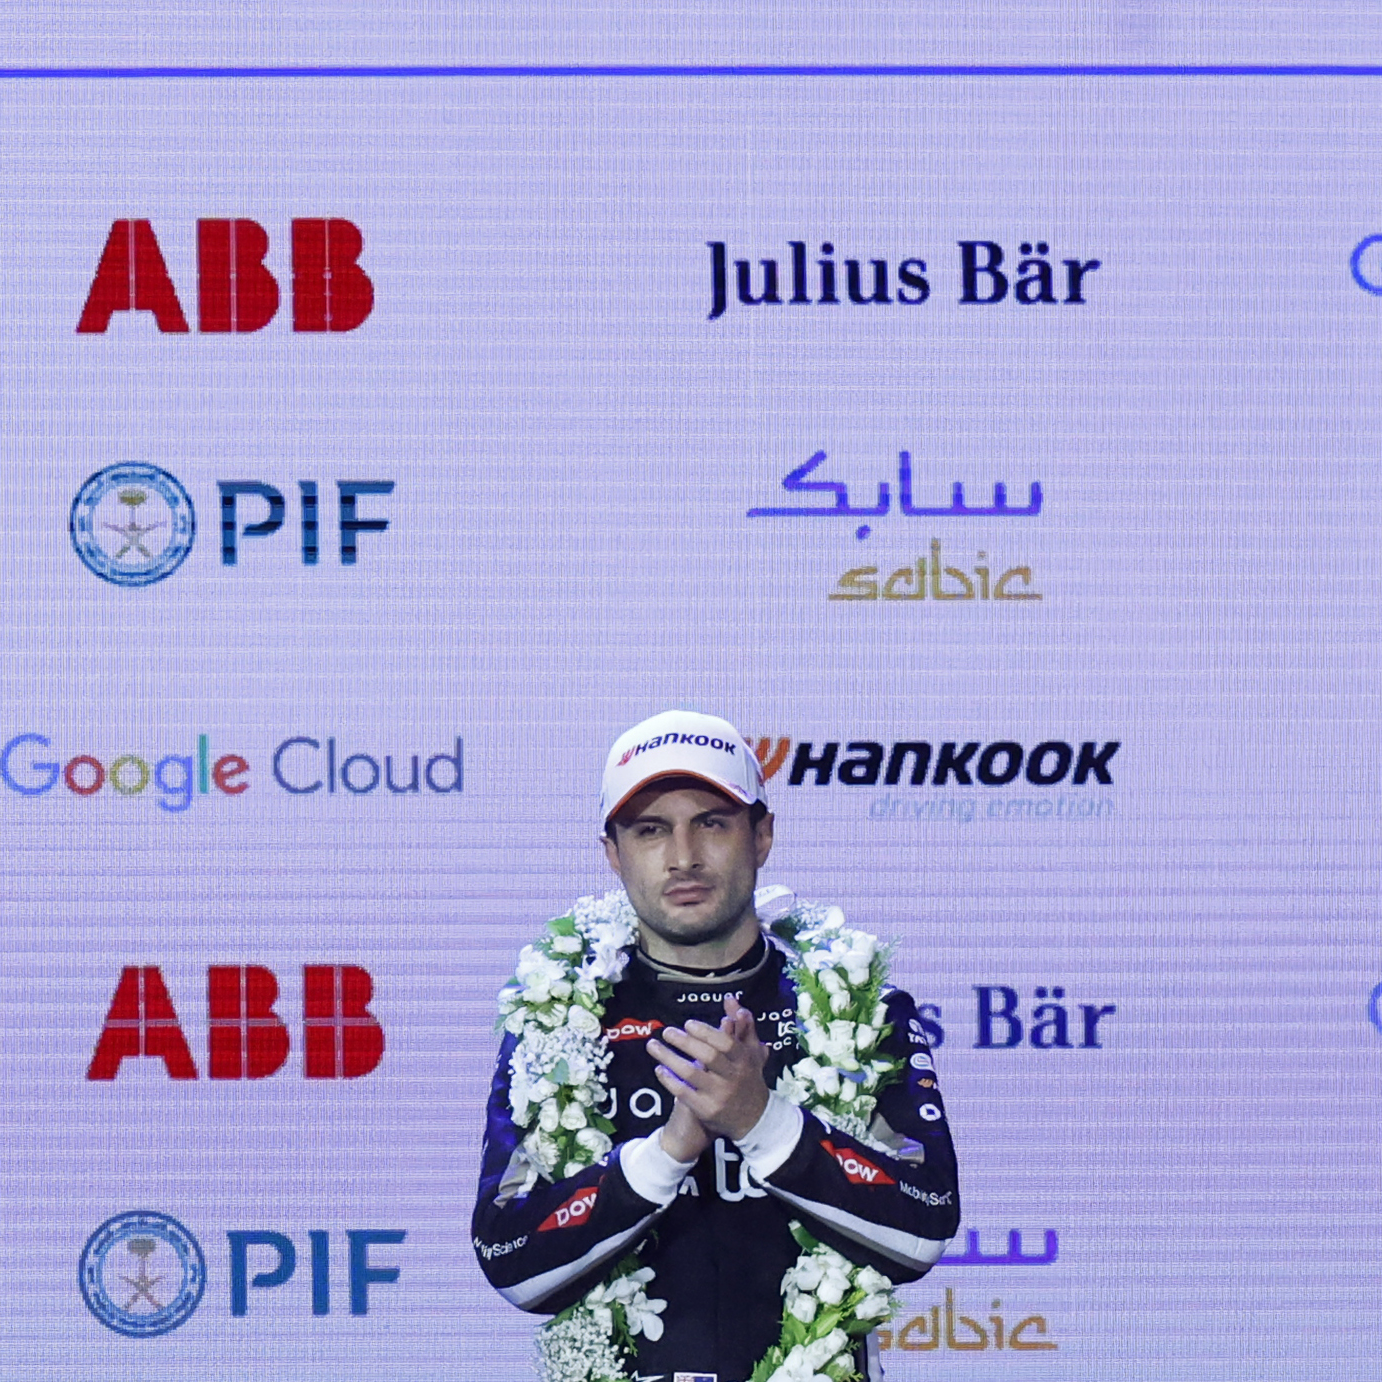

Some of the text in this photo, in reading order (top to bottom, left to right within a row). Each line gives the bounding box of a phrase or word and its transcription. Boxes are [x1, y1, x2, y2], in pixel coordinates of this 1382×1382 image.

[76, 218, 375, 333] ABB
[706, 241, 1102, 320] Julius Bär
[217, 480, 395, 566] PIF
[746, 450, 1043, 540] سابك
[272, 735, 465, 794] Cloud
[85, 964, 386, 1081] ABB
[605, 1022, 653, 1040] DOW
[971, 984, 1116, 1049] Bär
[836, 1153, 879, 1182] OW
[227, 1229, 407, 1317] PIF
